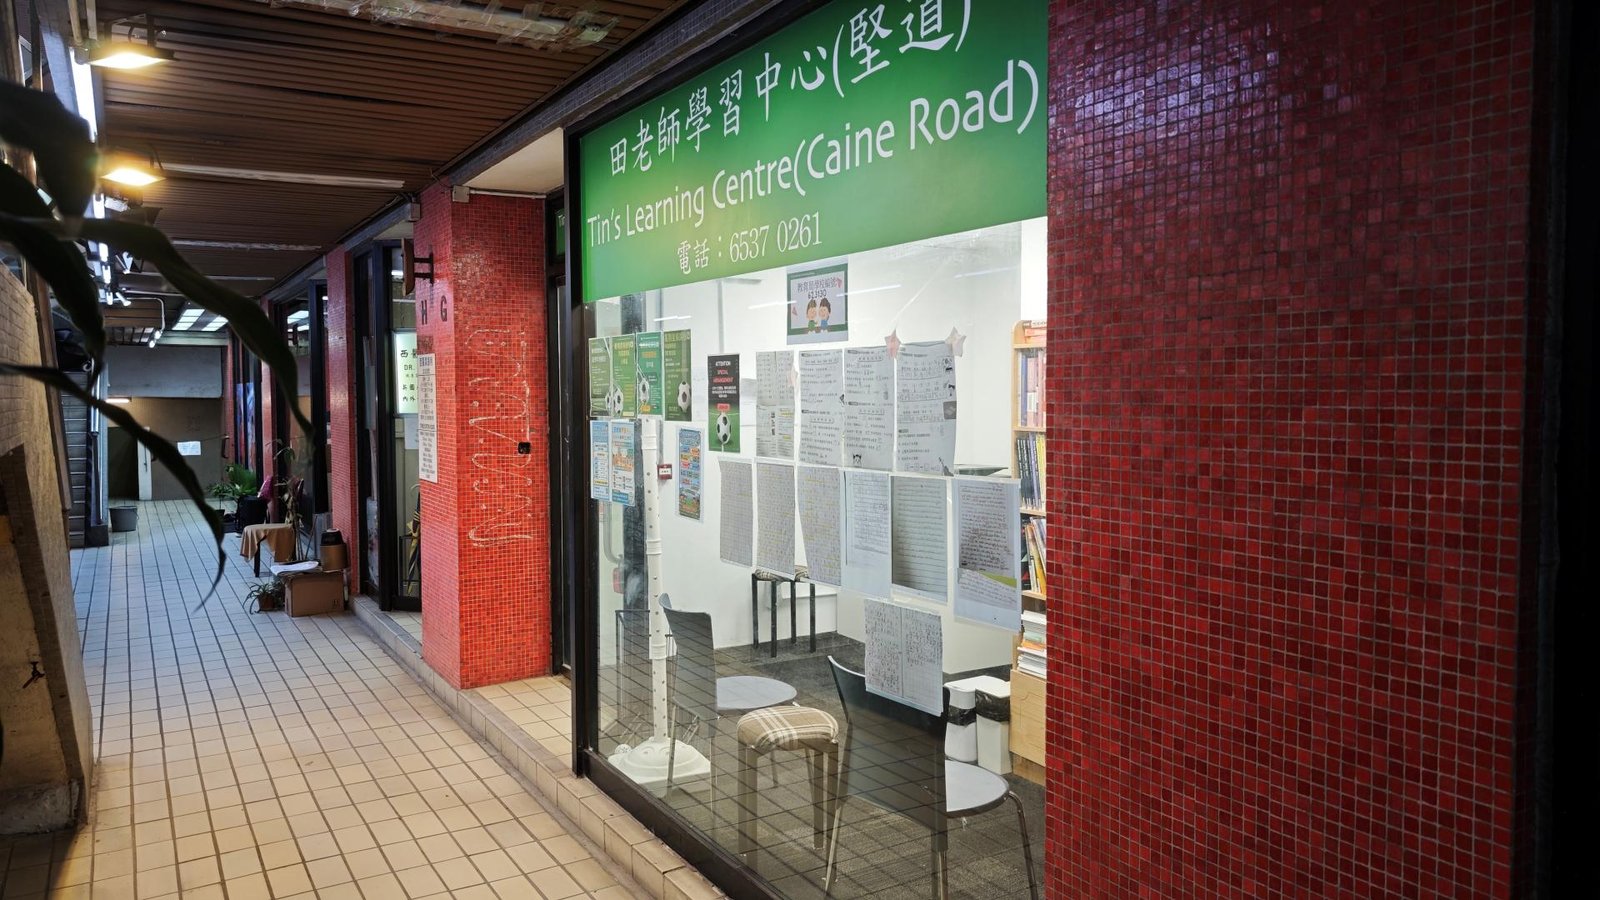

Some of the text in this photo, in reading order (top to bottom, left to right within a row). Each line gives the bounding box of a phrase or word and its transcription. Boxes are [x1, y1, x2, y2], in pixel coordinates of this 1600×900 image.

[587, 208, 621, 248] Tin's
[626, 185, 705, 236] Learning
[909, 59, 1039, 150] Road)
[729, 226, 771, 263] 6537
[777, 212, 822, 252] 0261
[421, 295, 448, 326] H G
